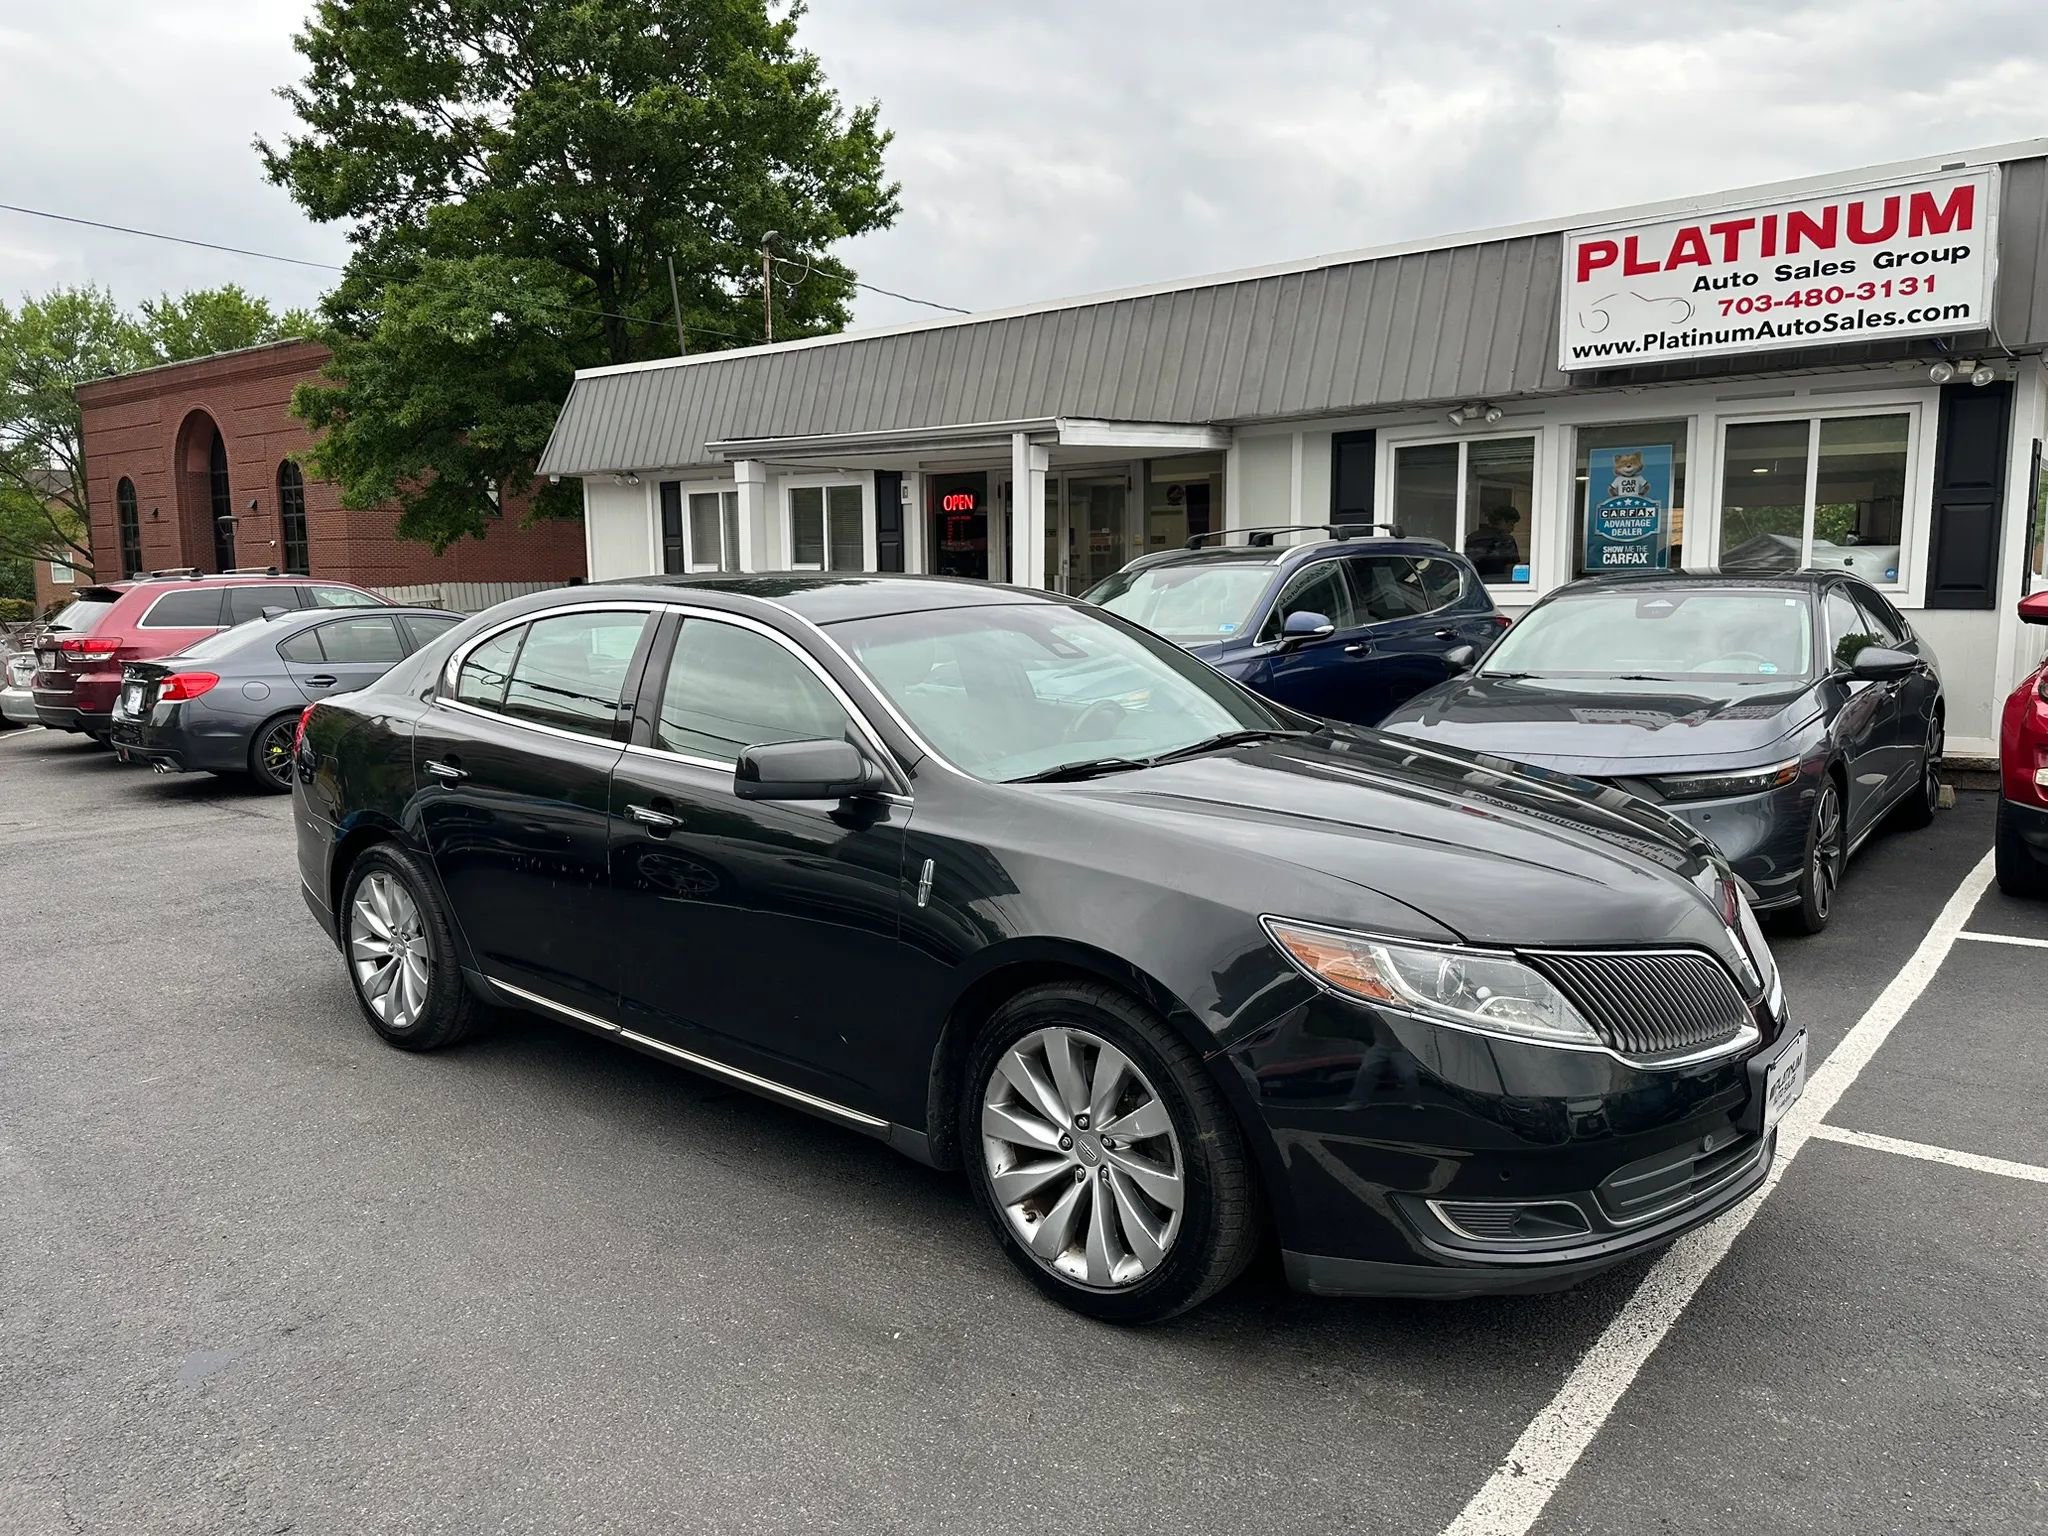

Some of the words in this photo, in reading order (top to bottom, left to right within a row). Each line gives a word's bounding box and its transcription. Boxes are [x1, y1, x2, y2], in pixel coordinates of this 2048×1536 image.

[1577, 185, 1975, 283] PLATINUM
[1692, 271, 1759, 293] Auto
[1774, 259, 1857, 283] Sales
[1872, 245, 1971, 269] Group
[1718, 275, 1936, 317] 703-480-3131
[1572, 301, 1971, 359] www.PlatinumAutoSales.com
[1621, 479, 1637, 487] CAR
[1622, 486, 1636, 494] FOX
[943, 494, 973, 511] OPEN
[1601, 508, 1655, 518] CARFAX
[1604, 519, 1651, 528] ADVANTAGE
[1611, 528, 1642, 536] DEALER
[1602, 545, 1624, 553] SHOW
[1635, 544, 1648, 552] THE
[1602, 553, 1648, 565] CARFAX
